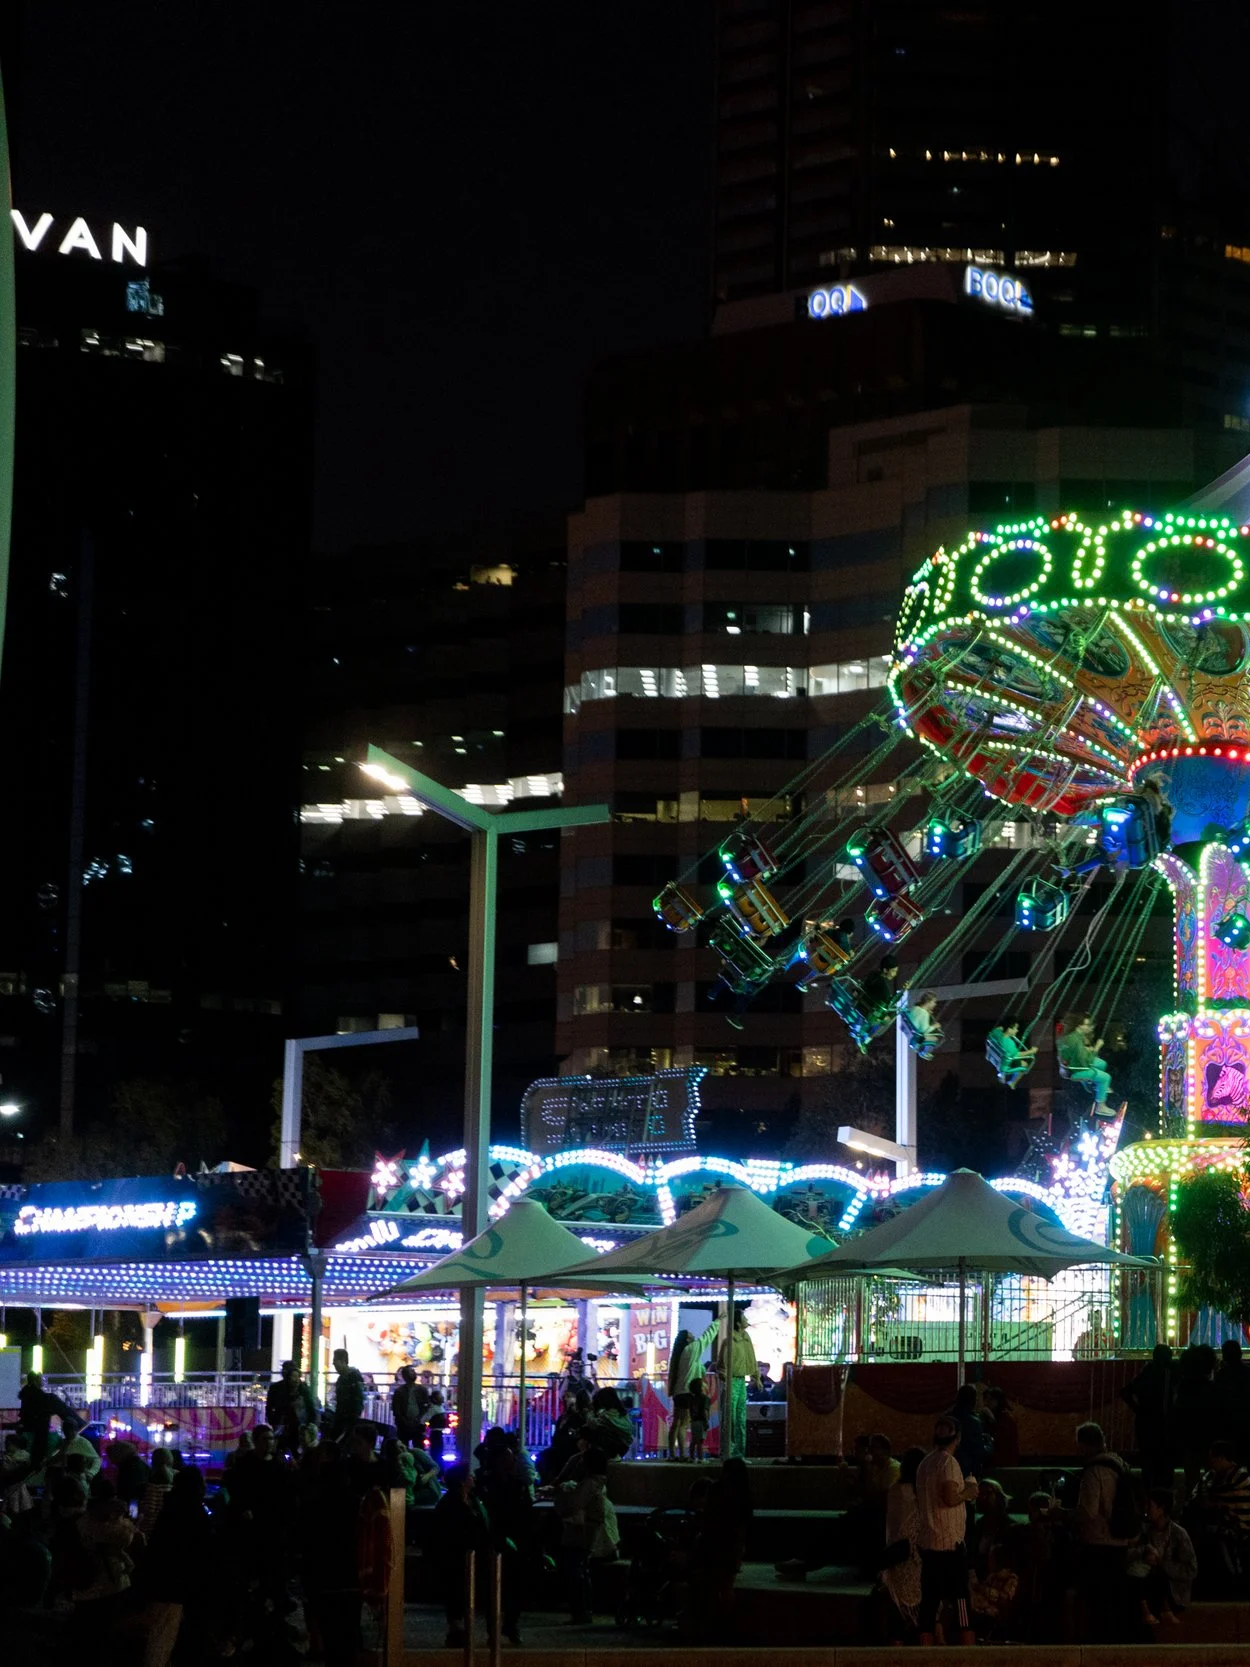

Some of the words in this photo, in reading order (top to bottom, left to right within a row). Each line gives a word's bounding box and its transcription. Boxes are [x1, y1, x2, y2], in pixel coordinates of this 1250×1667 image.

[10, 209, 148, 267] VAN
[964, 264, 1016, 307] BOQ
[635, 1305, 668, 1327] WIN
